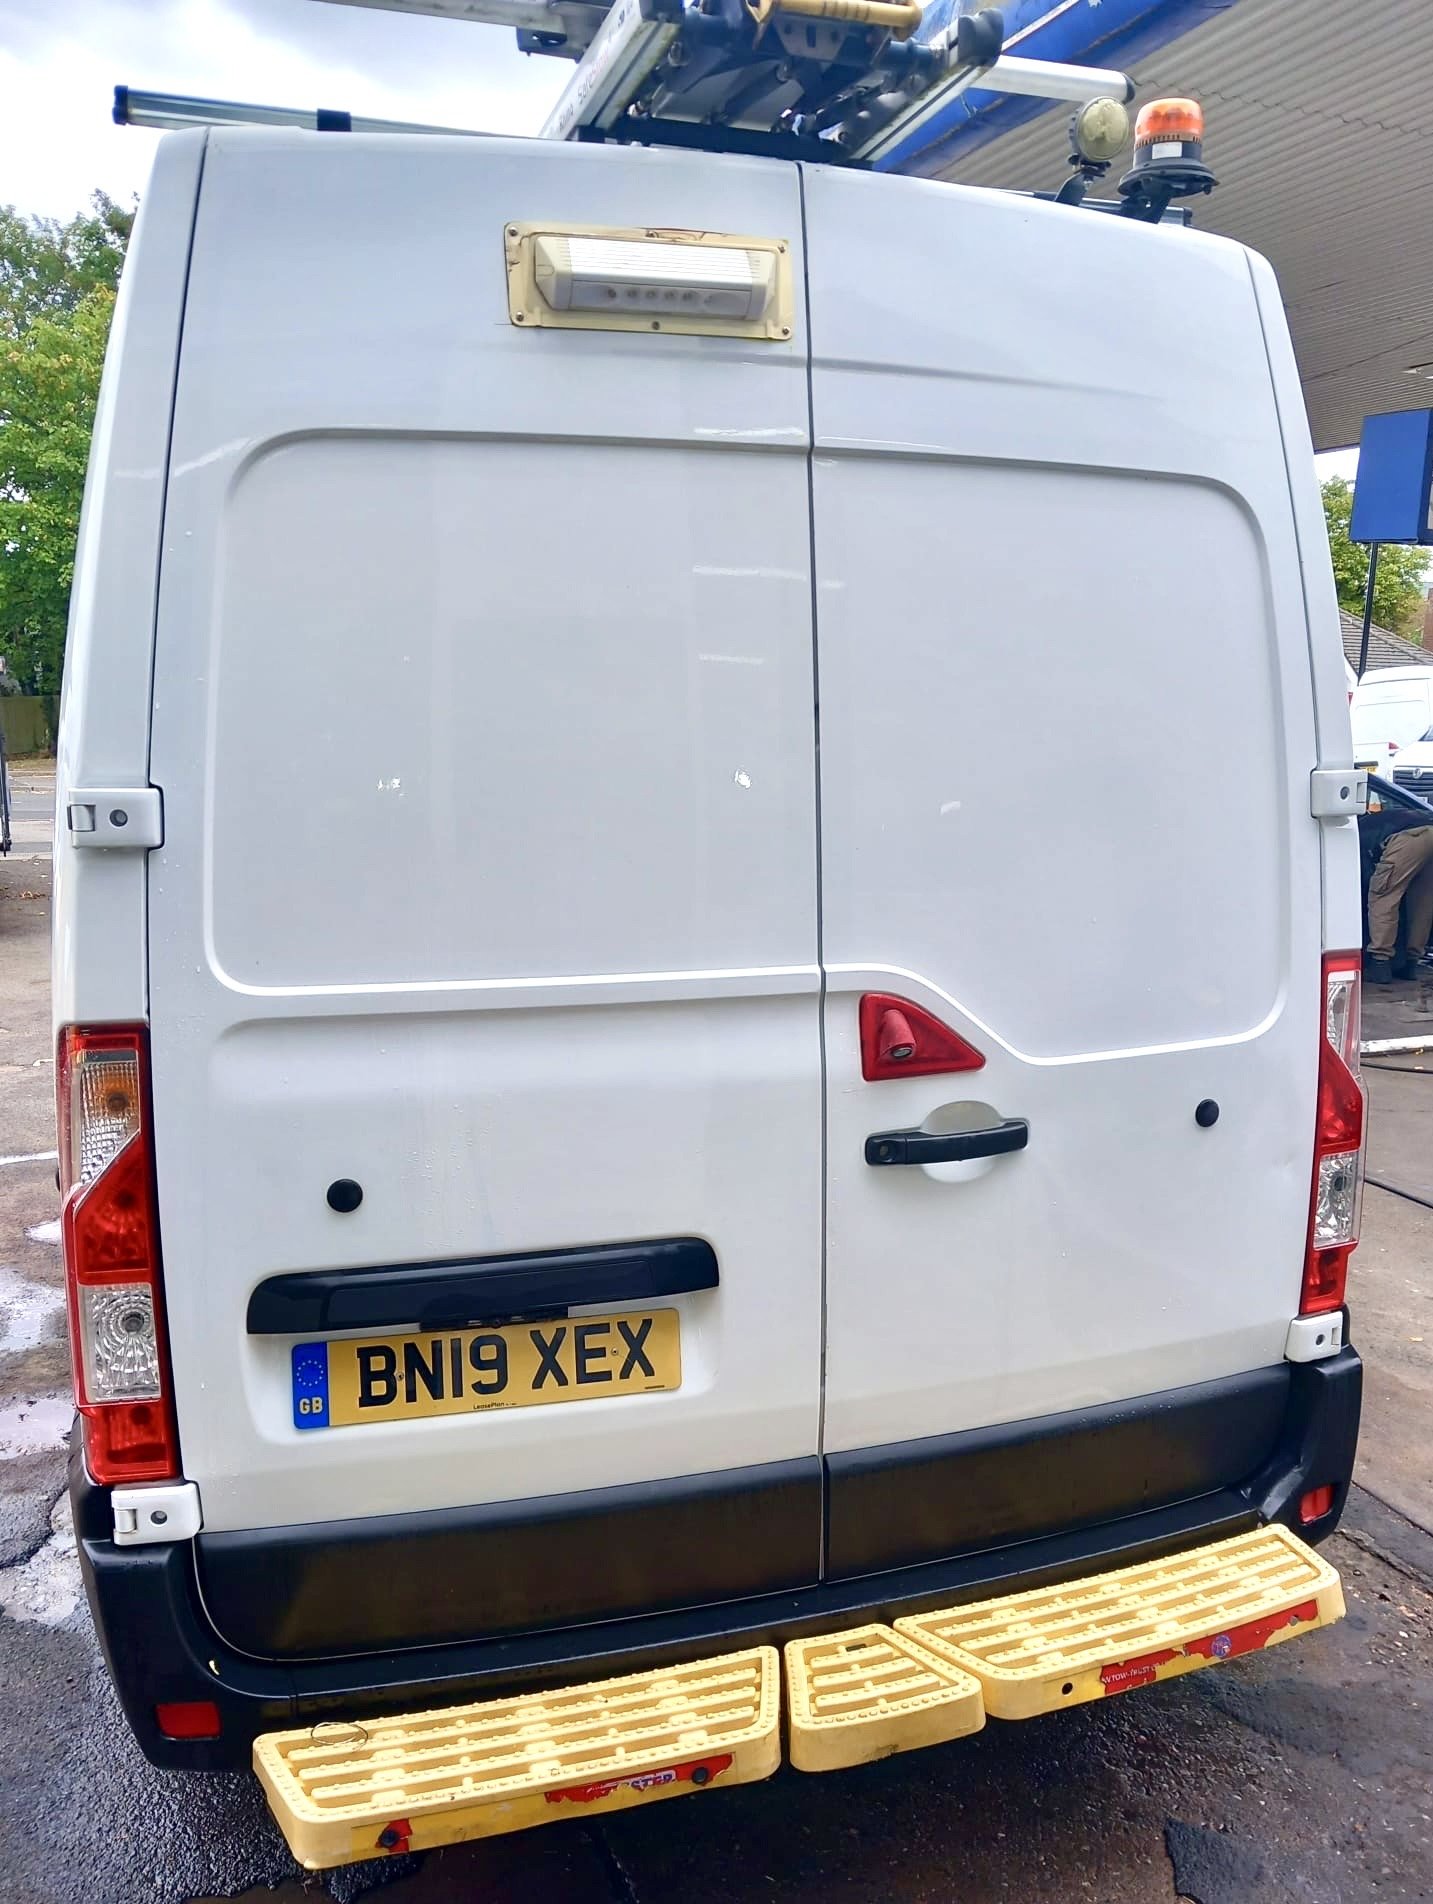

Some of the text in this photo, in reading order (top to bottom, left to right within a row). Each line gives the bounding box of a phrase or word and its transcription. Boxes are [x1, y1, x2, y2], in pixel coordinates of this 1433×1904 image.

[356, 1318, 655, 1408] BN19 XEX
[299, 1397, 323, 1414] GB
